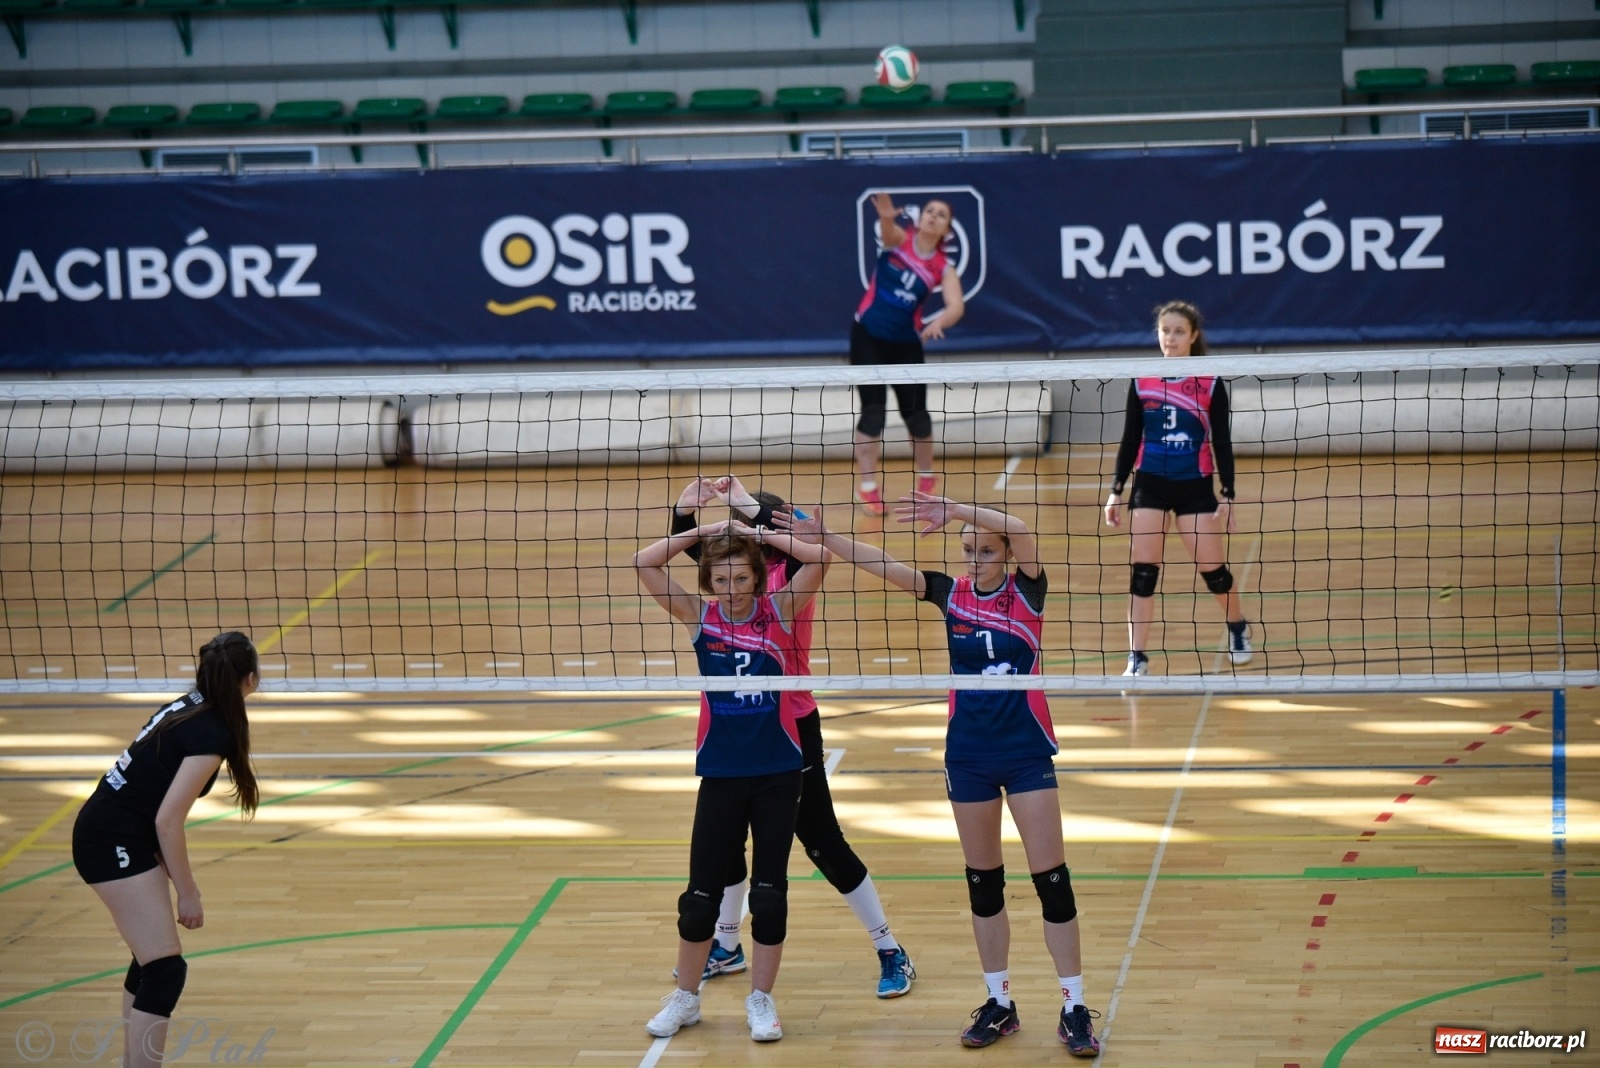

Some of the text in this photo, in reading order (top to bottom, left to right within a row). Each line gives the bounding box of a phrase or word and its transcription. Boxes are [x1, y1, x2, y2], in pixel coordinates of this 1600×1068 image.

[1060, 199, 1445, 279] RACIBÓRZ
[0, 226, 321, 302] ACIBÓRZ
[568, 284, 696, 312] RACIBÓRZ
[1162, 405, 1177, 429] 3
[976, 630, 995, 659] 7
[734, 651, 751, 677] 2
[116, 845, 130, 869] 5
